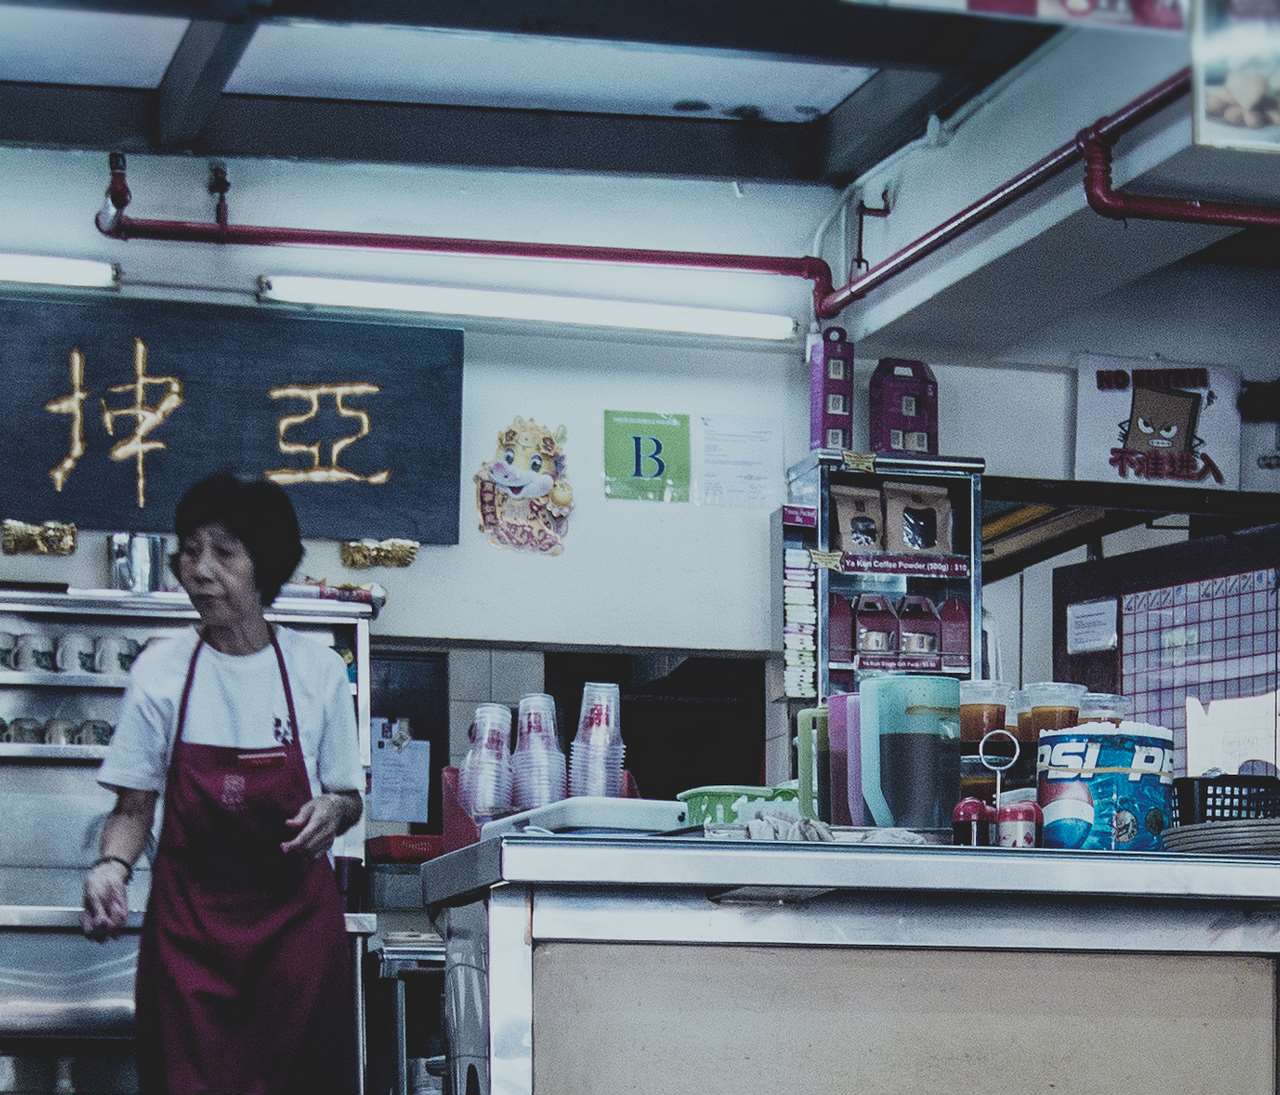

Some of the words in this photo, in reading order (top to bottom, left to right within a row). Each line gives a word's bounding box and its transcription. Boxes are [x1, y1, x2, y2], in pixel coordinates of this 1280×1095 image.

[631, 435, 666, 479] B
[845, 559, 856, 567] Ya
[873, 560, 898, 570] Coffee
[898, 561, 926, 571] Powder
